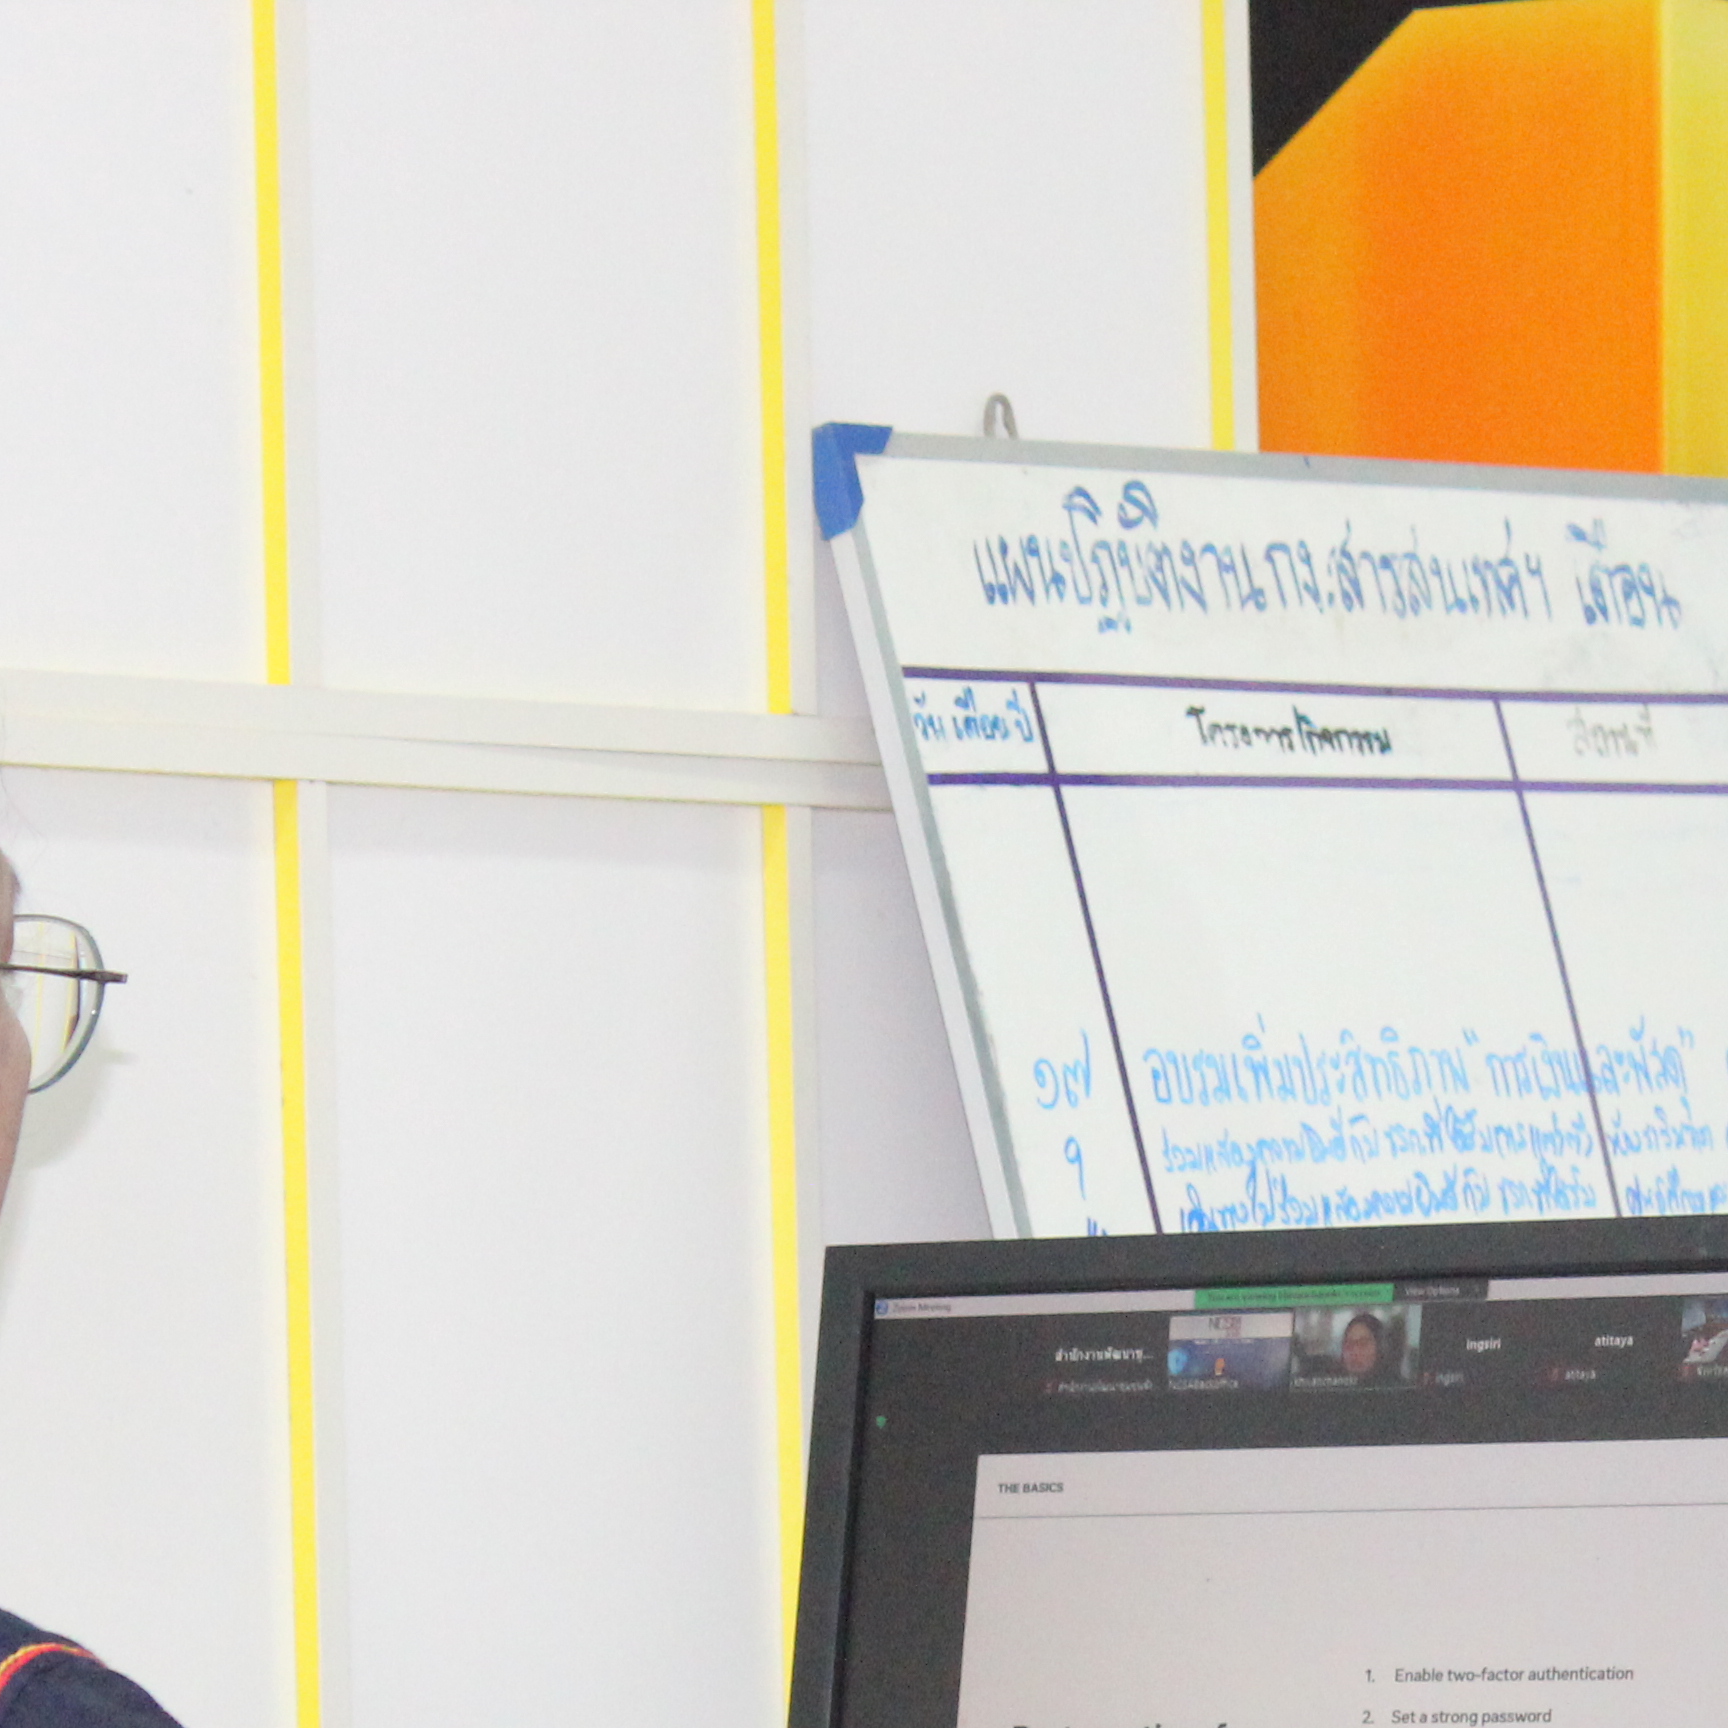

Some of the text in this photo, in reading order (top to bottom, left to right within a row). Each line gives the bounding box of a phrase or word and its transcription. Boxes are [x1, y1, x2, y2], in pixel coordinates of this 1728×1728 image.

[998, 1482, 1064, 1494] THE BASICS
[1395, 1667, 1443, 1682] Enable
[1447, 1666, 1524, 1682] two-factor
[1528, 1666, 1634, 1681] authentication
[1391, 1709, 1416, 1724] Set
[1419, 1713, 1428, 1724] a
[1431, 1709, 1478, 1727] strong
[1481, 1709, 1552, 1727] password
